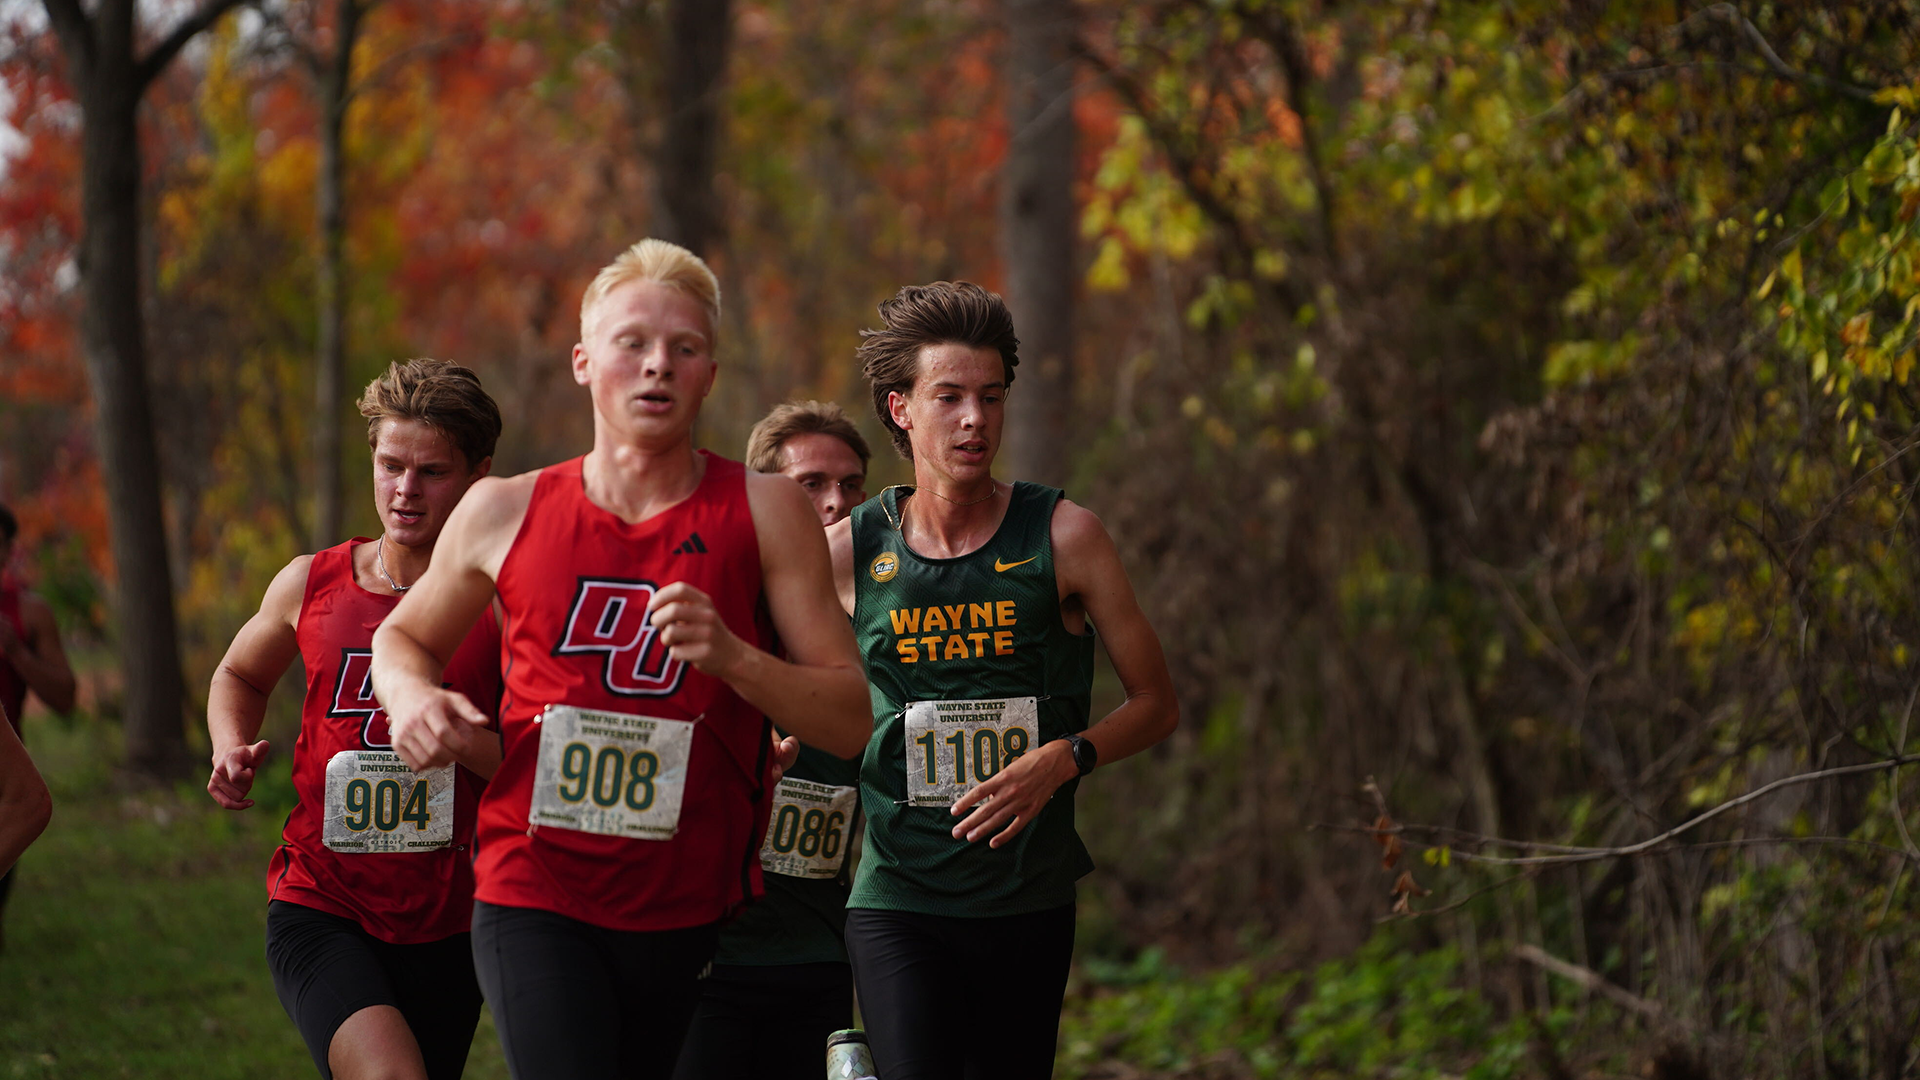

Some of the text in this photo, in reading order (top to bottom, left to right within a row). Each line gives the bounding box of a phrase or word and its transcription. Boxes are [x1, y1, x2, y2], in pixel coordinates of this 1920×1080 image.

[890, 600, 1018, 635] WAYNE
[896, 630, 1014, 664] STATE
[935, 702, 1006, 711] WAYNE STATE
[579, 713, 657, 731] WAYNE STATE
[940, 713, 1002, 722] UNIVERSITY
[582, 726, 651, 741] UNIVERSITY
[915, 726, 1029, 785] 1108
[360, 764, 412, 773] UNIVERSI
[557, 741, 661, 812] 908
[781, 780, 811, 790] WAYNE
[781, 789, 833, 803] UNIVERSITY
[345, 778, 431, 833] 904
[770, 803, 845, 860] 086
